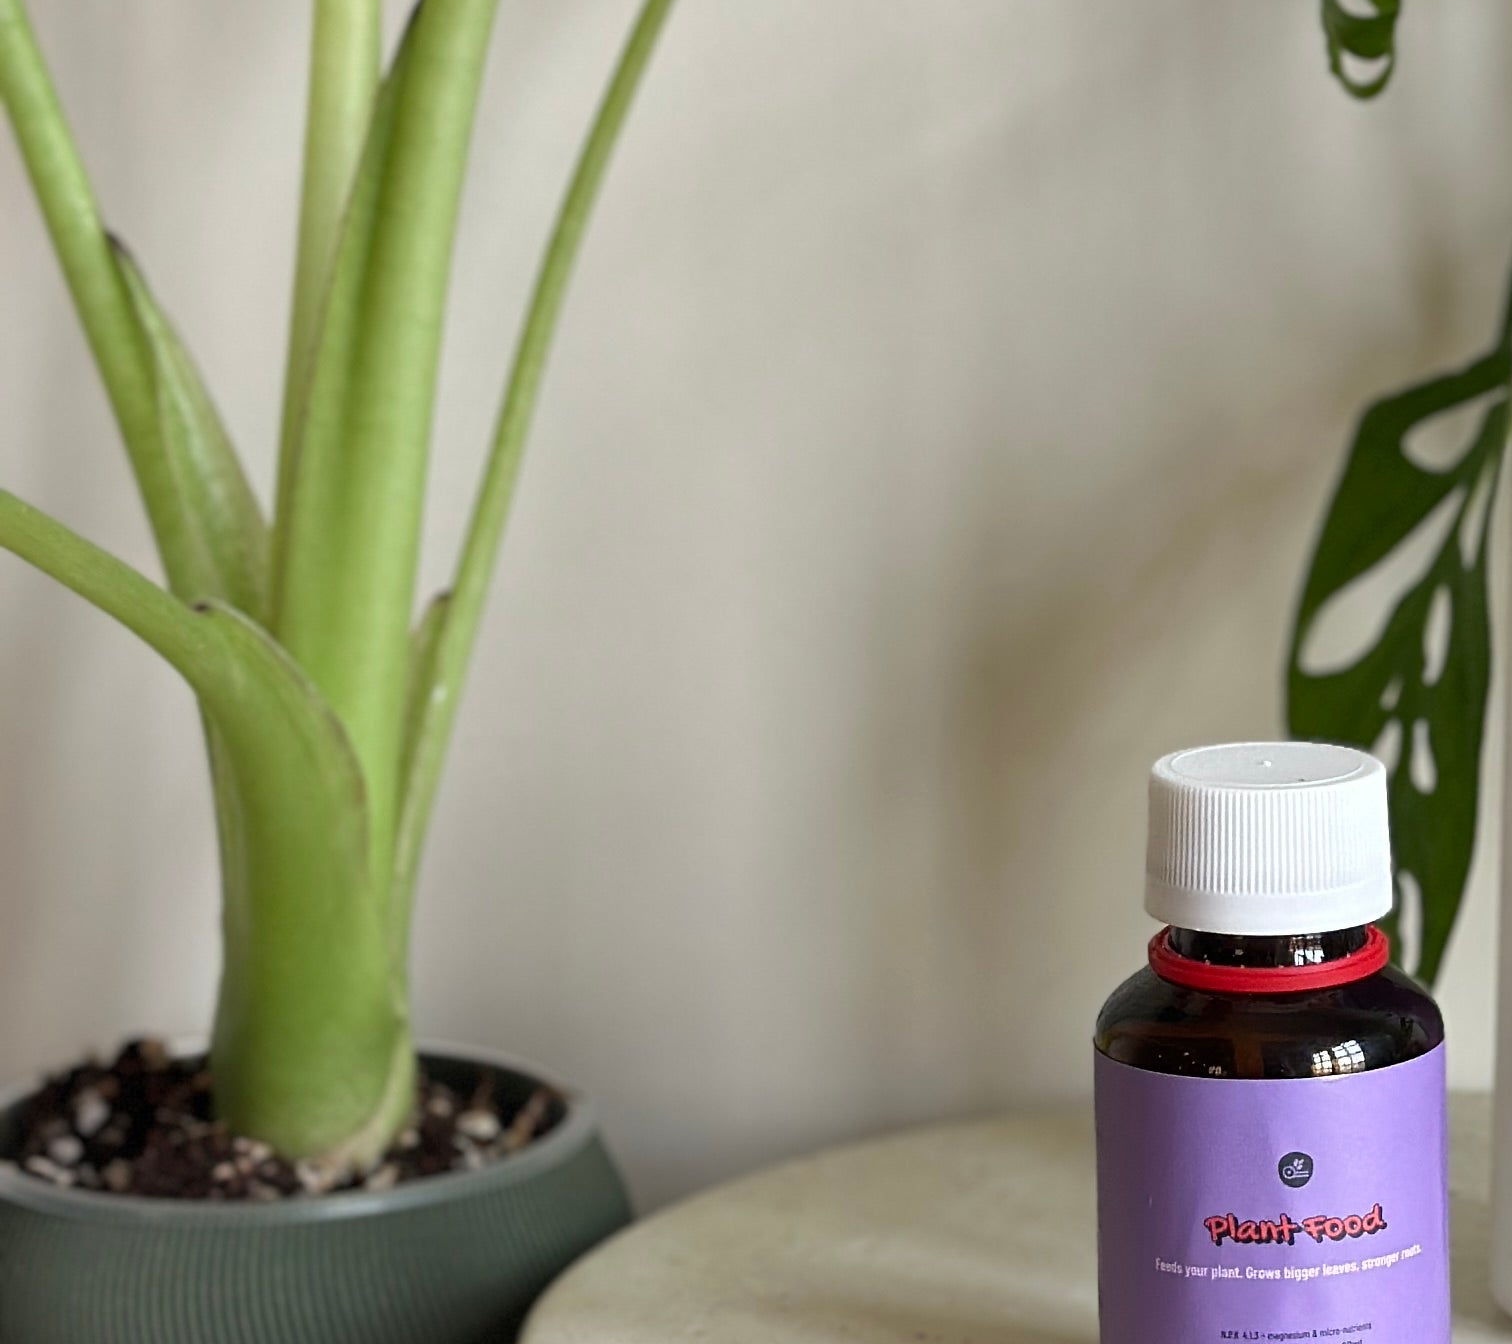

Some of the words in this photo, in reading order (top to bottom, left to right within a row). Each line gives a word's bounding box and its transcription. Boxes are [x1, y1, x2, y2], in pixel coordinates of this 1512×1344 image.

[1203, 1213, 1300, 1246] Plant
[1301, 1203, 1387, 1243] Food
[1155, 1258, 1183, 1274] Feeds
[1185, 1265, 1208, 1277] your
[1211, 1264, 1243, 1280] plant.
[1245, 1266, 1281, 1279] Grows
[1283, 1266, 1320, 1281] bigger
[1361, 1252, 1400, 1270] stronger
[1401, 1244, 1422, 1260] roots.
